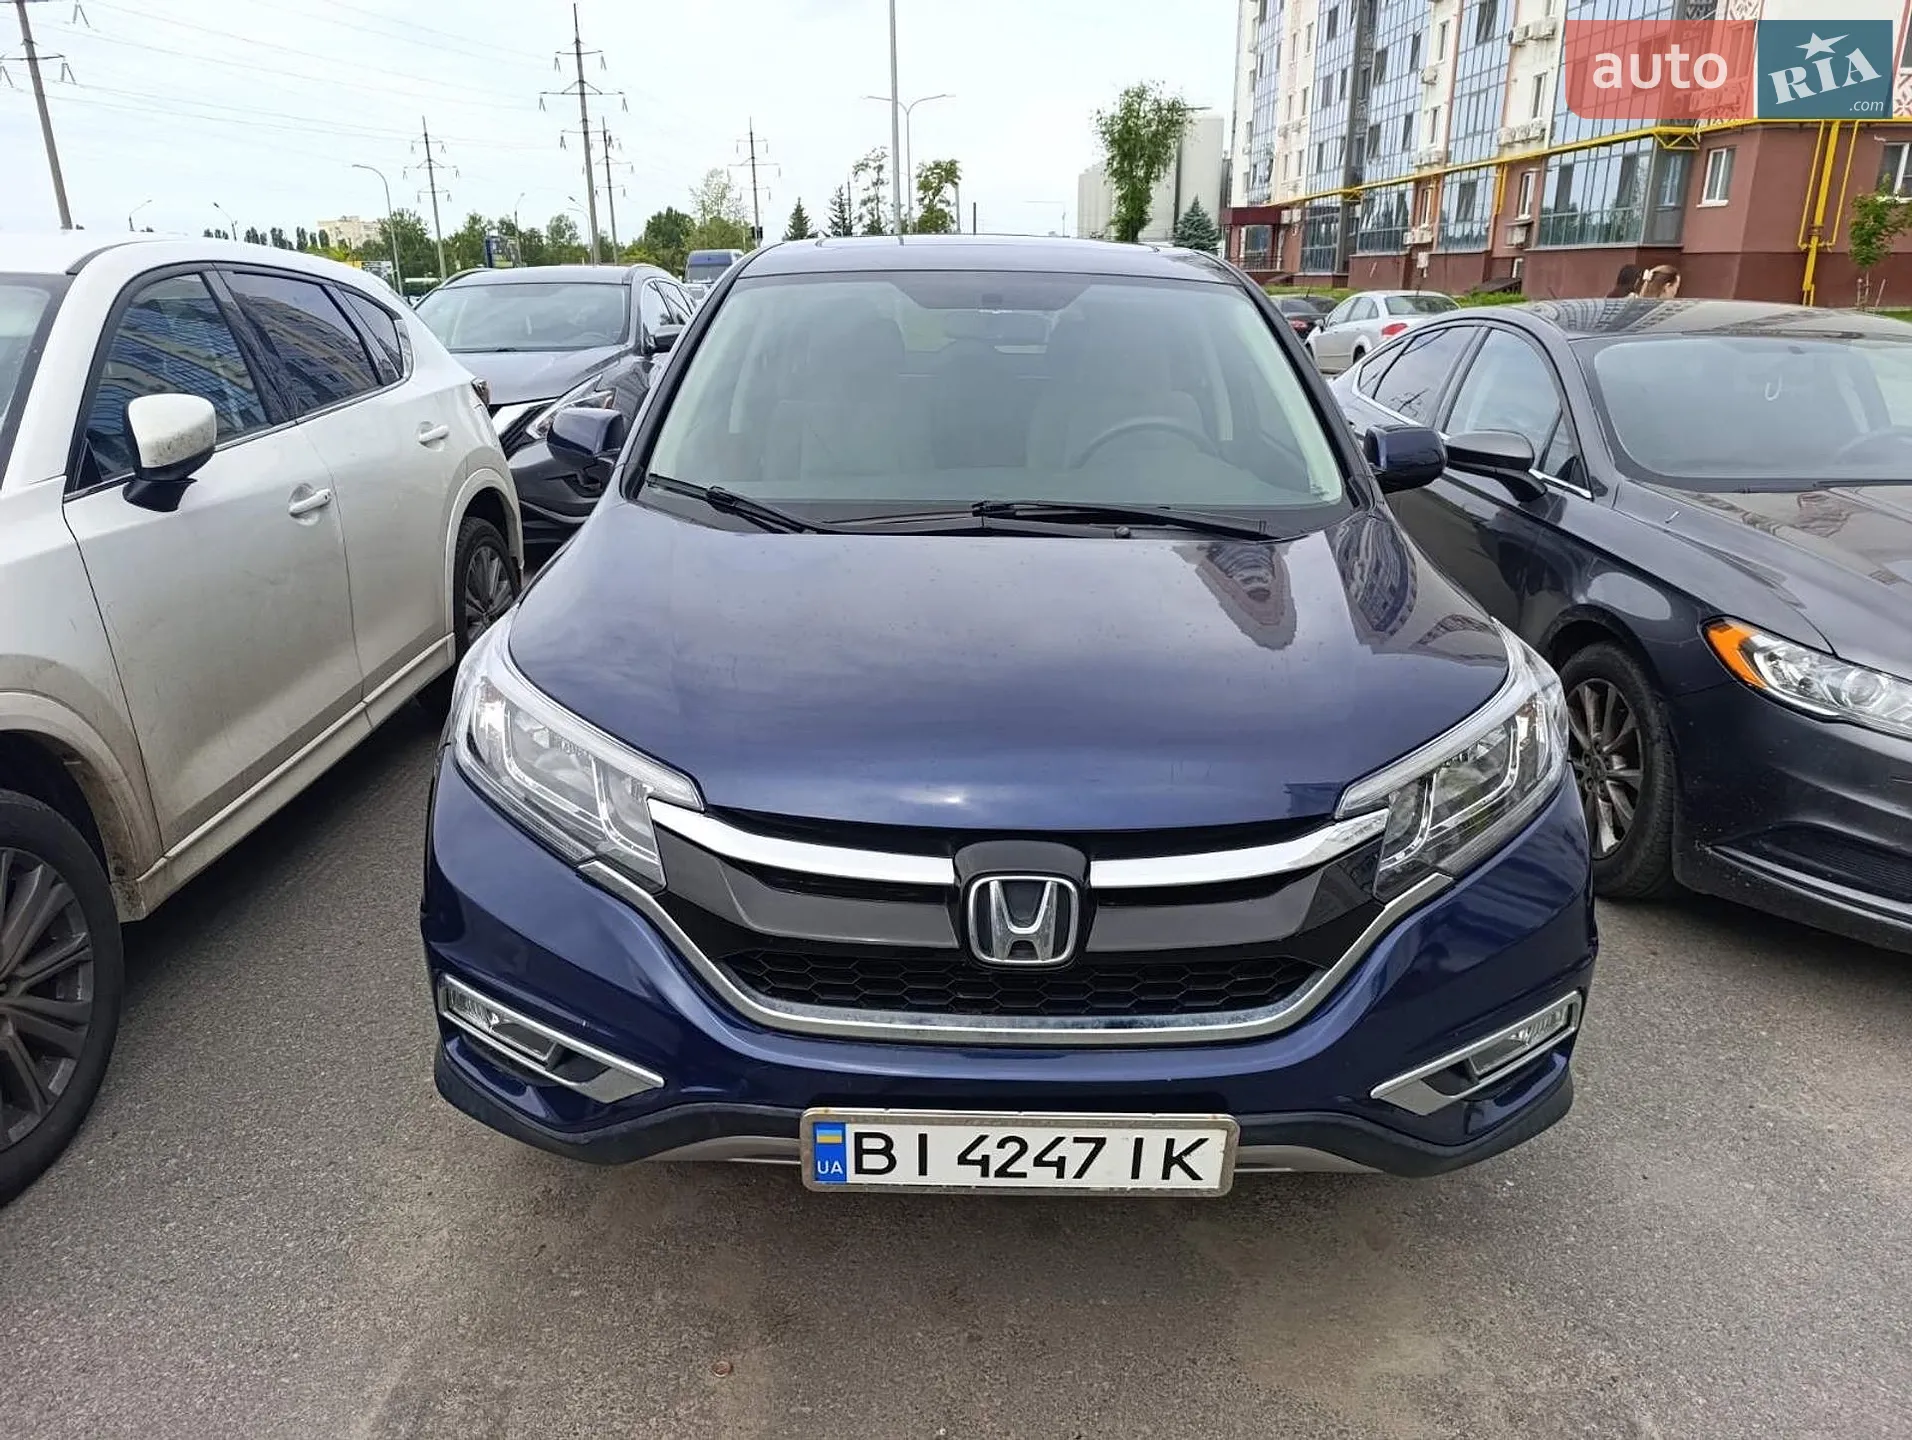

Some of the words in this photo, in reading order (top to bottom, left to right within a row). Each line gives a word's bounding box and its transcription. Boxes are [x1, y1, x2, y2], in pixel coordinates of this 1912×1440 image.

[816, 1160, 844, 1176] UA
[853, 1131, 928, 1177] BI
[957, 1134, 1107, 1179] 4247
[1131, 1137, 1209, 1181] IK
